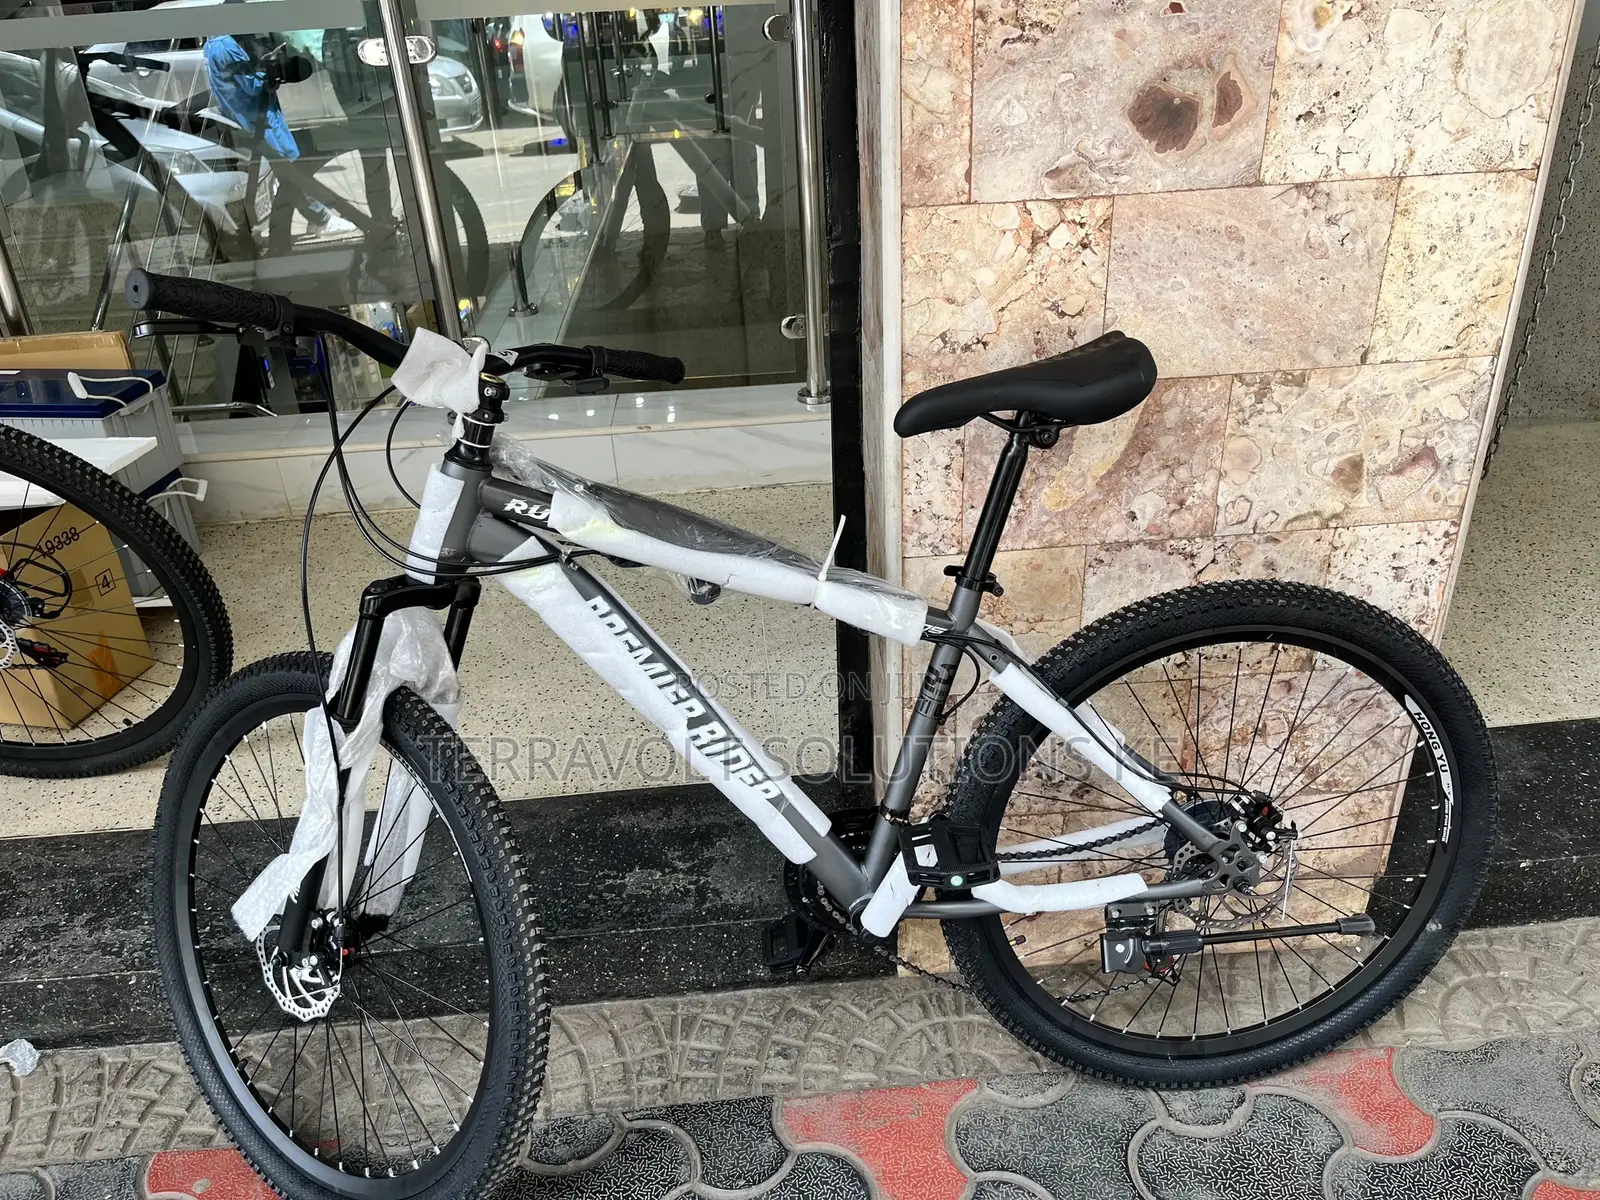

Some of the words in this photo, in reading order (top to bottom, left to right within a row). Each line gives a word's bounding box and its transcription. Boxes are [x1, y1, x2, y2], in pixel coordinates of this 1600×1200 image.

[503, 497, 551, 521] RU
[38, 527, 80, 559] 19338
[102, 575, 111, 589] 4
[1413, 711, 1440, 750] HONG
[1436, 753, 1449, 773] YU
